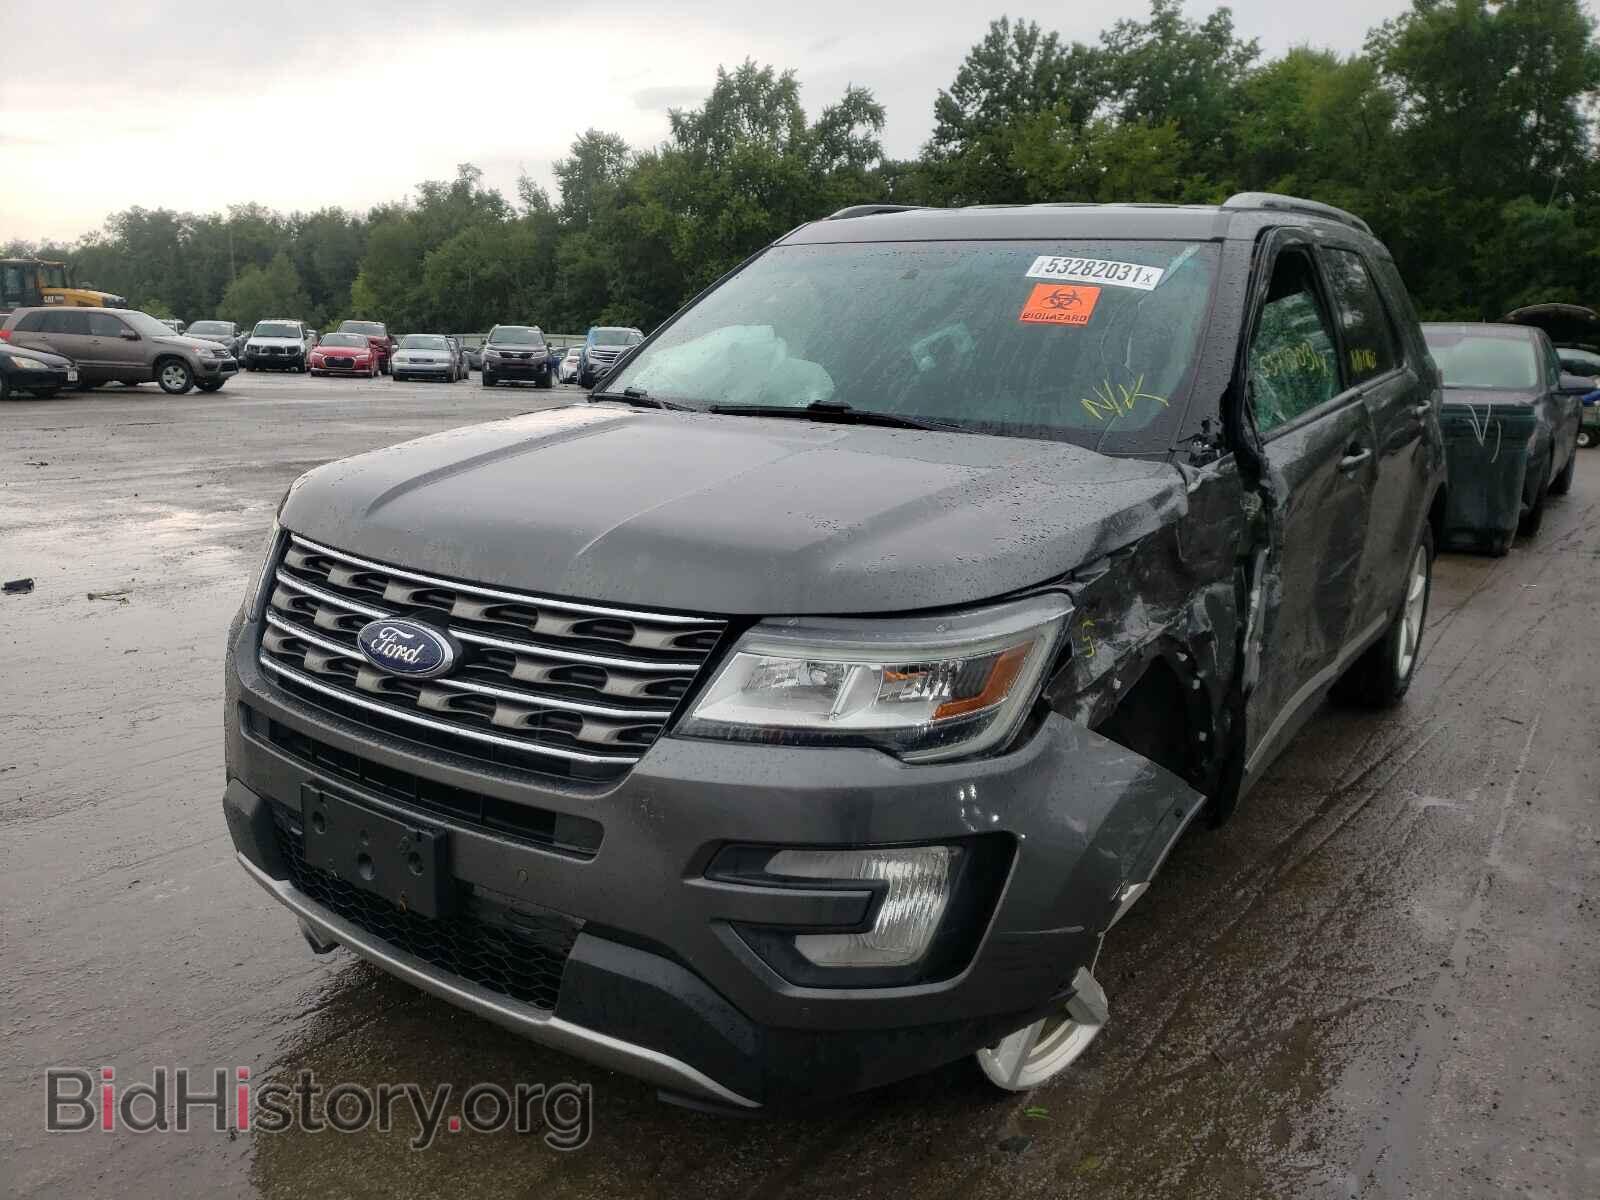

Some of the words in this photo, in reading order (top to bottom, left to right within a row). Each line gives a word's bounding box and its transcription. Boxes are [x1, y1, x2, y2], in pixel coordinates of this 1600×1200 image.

[1045, 257, 1143, 283] 53282031
[1022, 311, 1088, 323] BIOHAZARD
[370, 626, 425, 665] Ford
